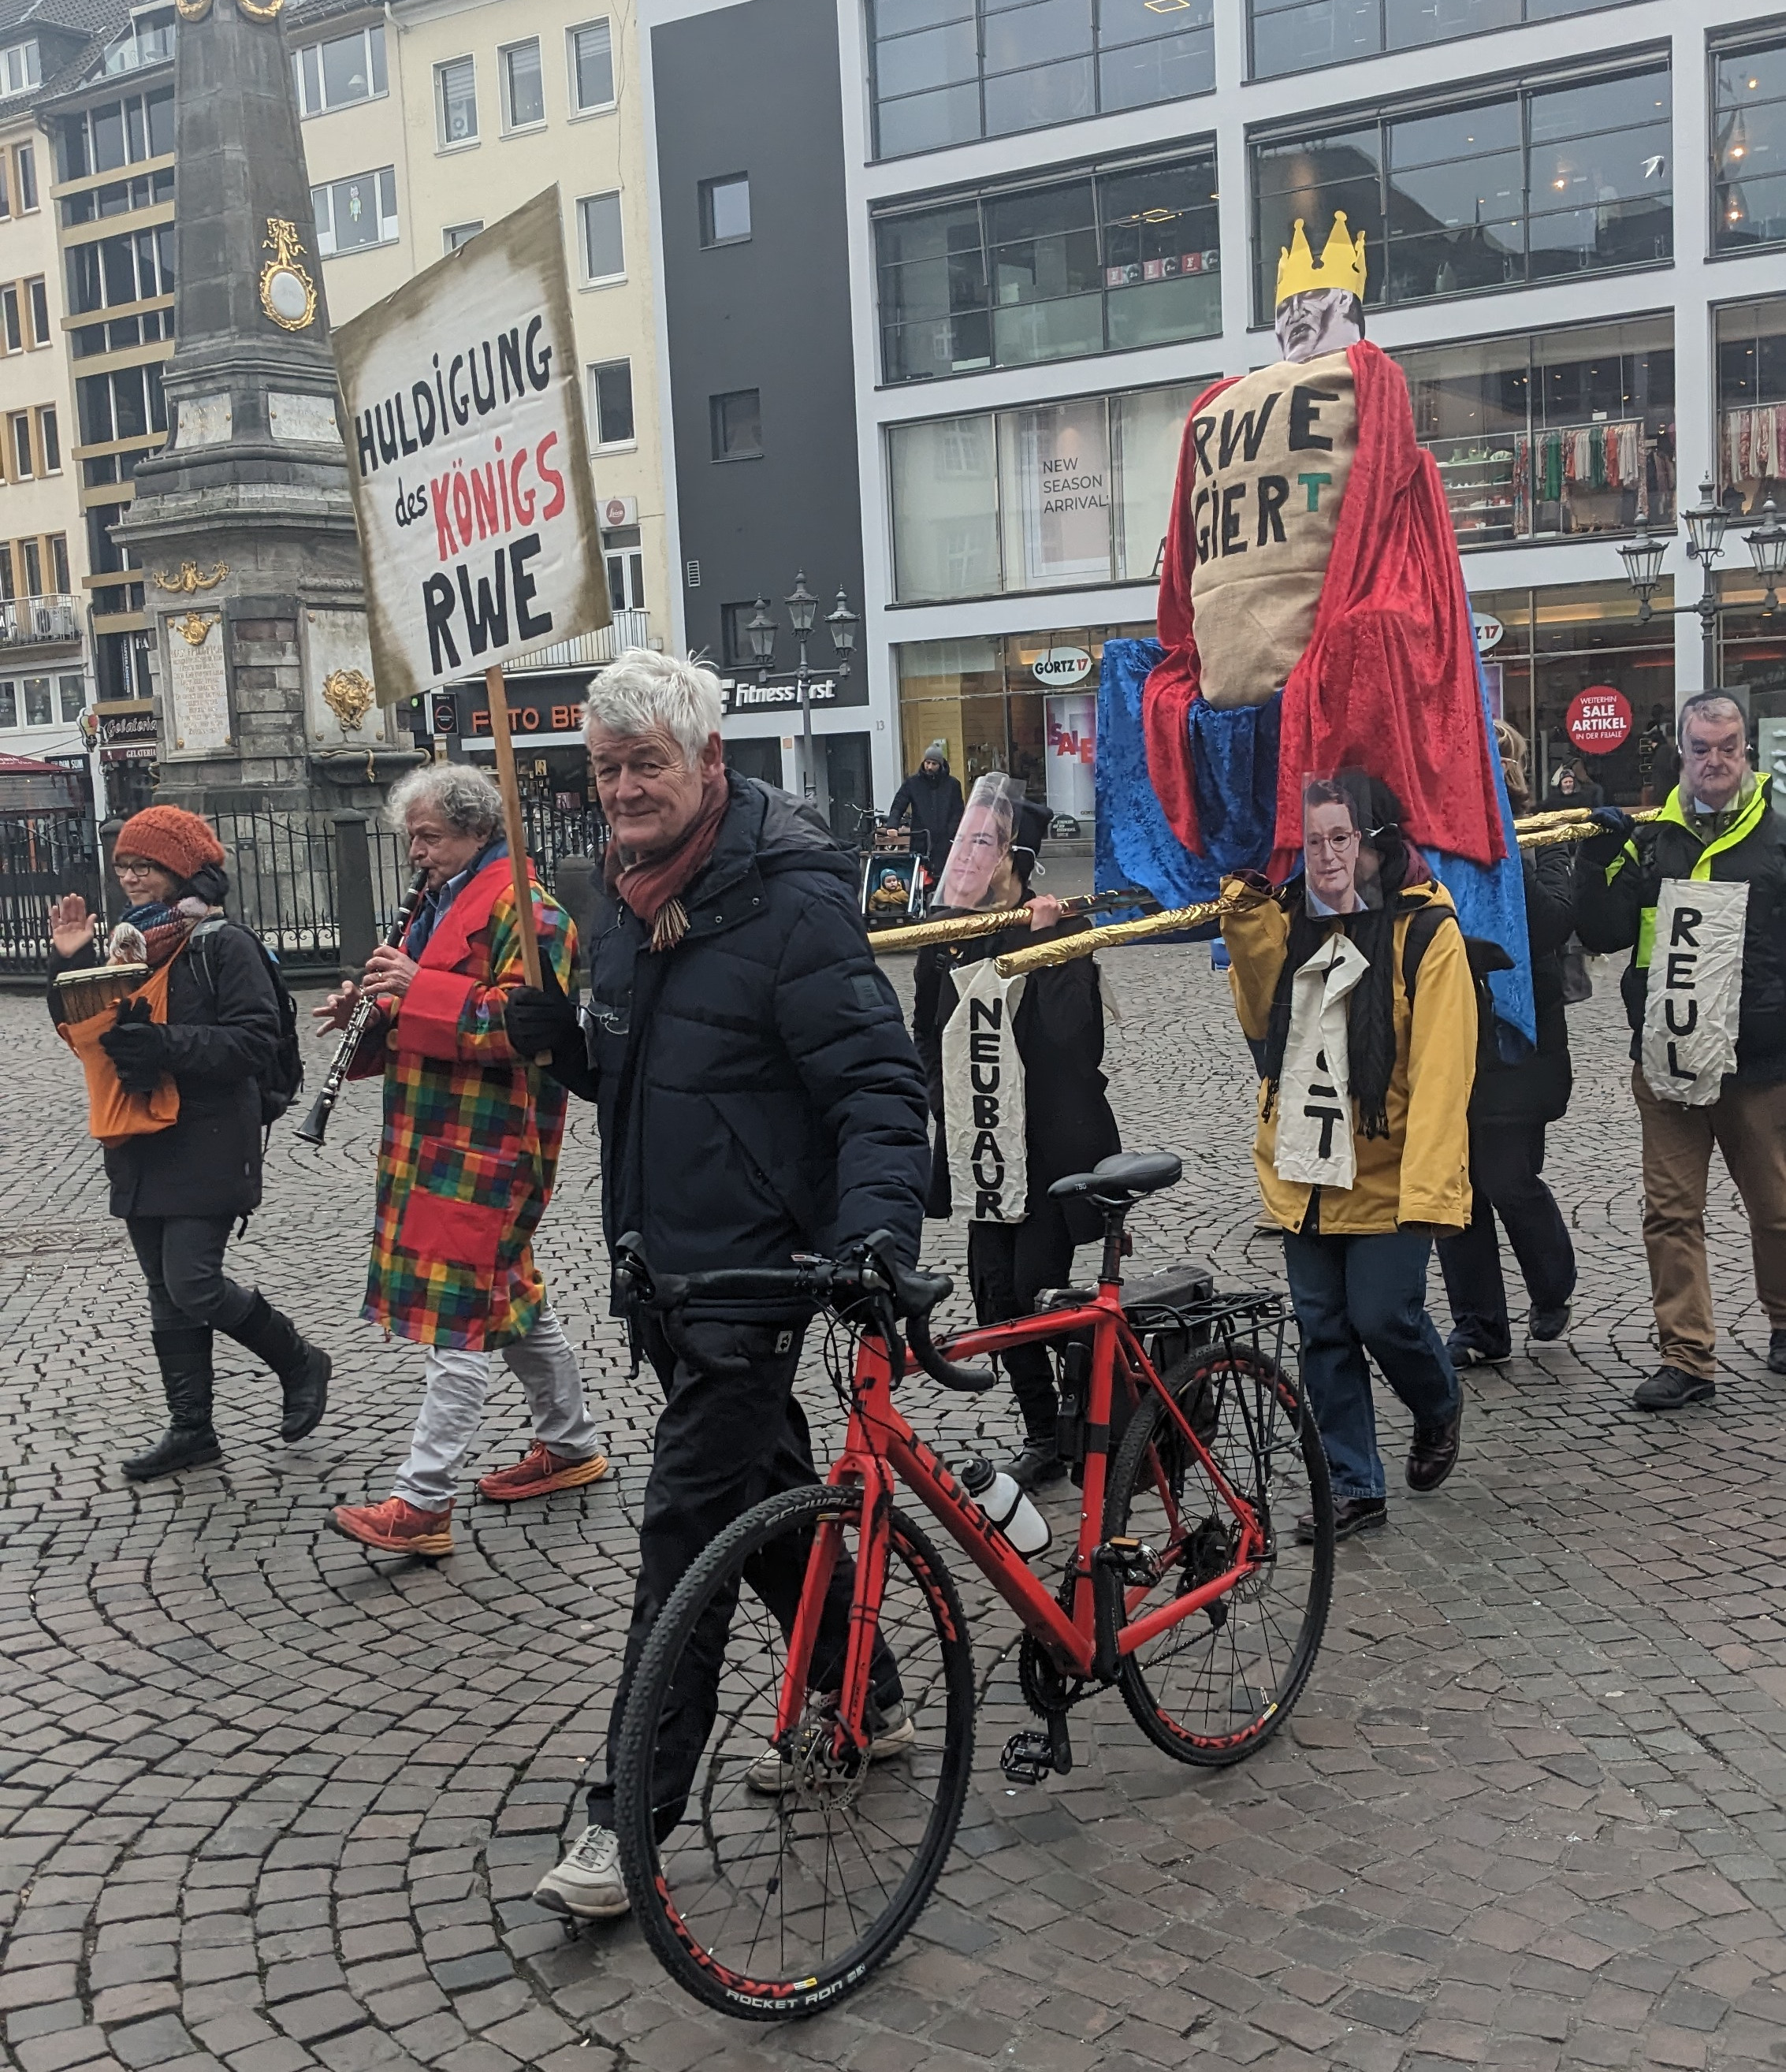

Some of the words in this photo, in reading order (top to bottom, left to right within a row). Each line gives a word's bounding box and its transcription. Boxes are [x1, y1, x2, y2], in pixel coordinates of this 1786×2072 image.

[1193, 385, 1340, 478] RWE
[1043, 457, 1078, 474] NEW
[1043, 474, 1103, 493] SEASON
[396, 477, 427, 528] des
[422, 533, 553, 675] RWE
[1484, 625, 1499, 639] 17
[1077, 658, 1089, 671] 17
[735, 683, 795, 707] Fitness
[797, 679, 836, 702] Frst
[1579, 696, 1617, 705] WEITERHIN
[473, 707, 539, 734] FTO
[1583, 704, 1615, 718] SALE
[107, 716, 158, 738] Gelateria
[876, 720, 885, 731] 13
[1572, 716, 1627, 731] ARTIKEL
[126, 748, 157, 758] GELATERIA
[1051, 723, 1094, 764] SALE
[1665, 906, 1703, 1081] REUL
[969, 997, 1006, 1221] NEUBAUR
[725, 1989, 798, 2010] ROCKET
[805, 1979, 843, 2005] RON
